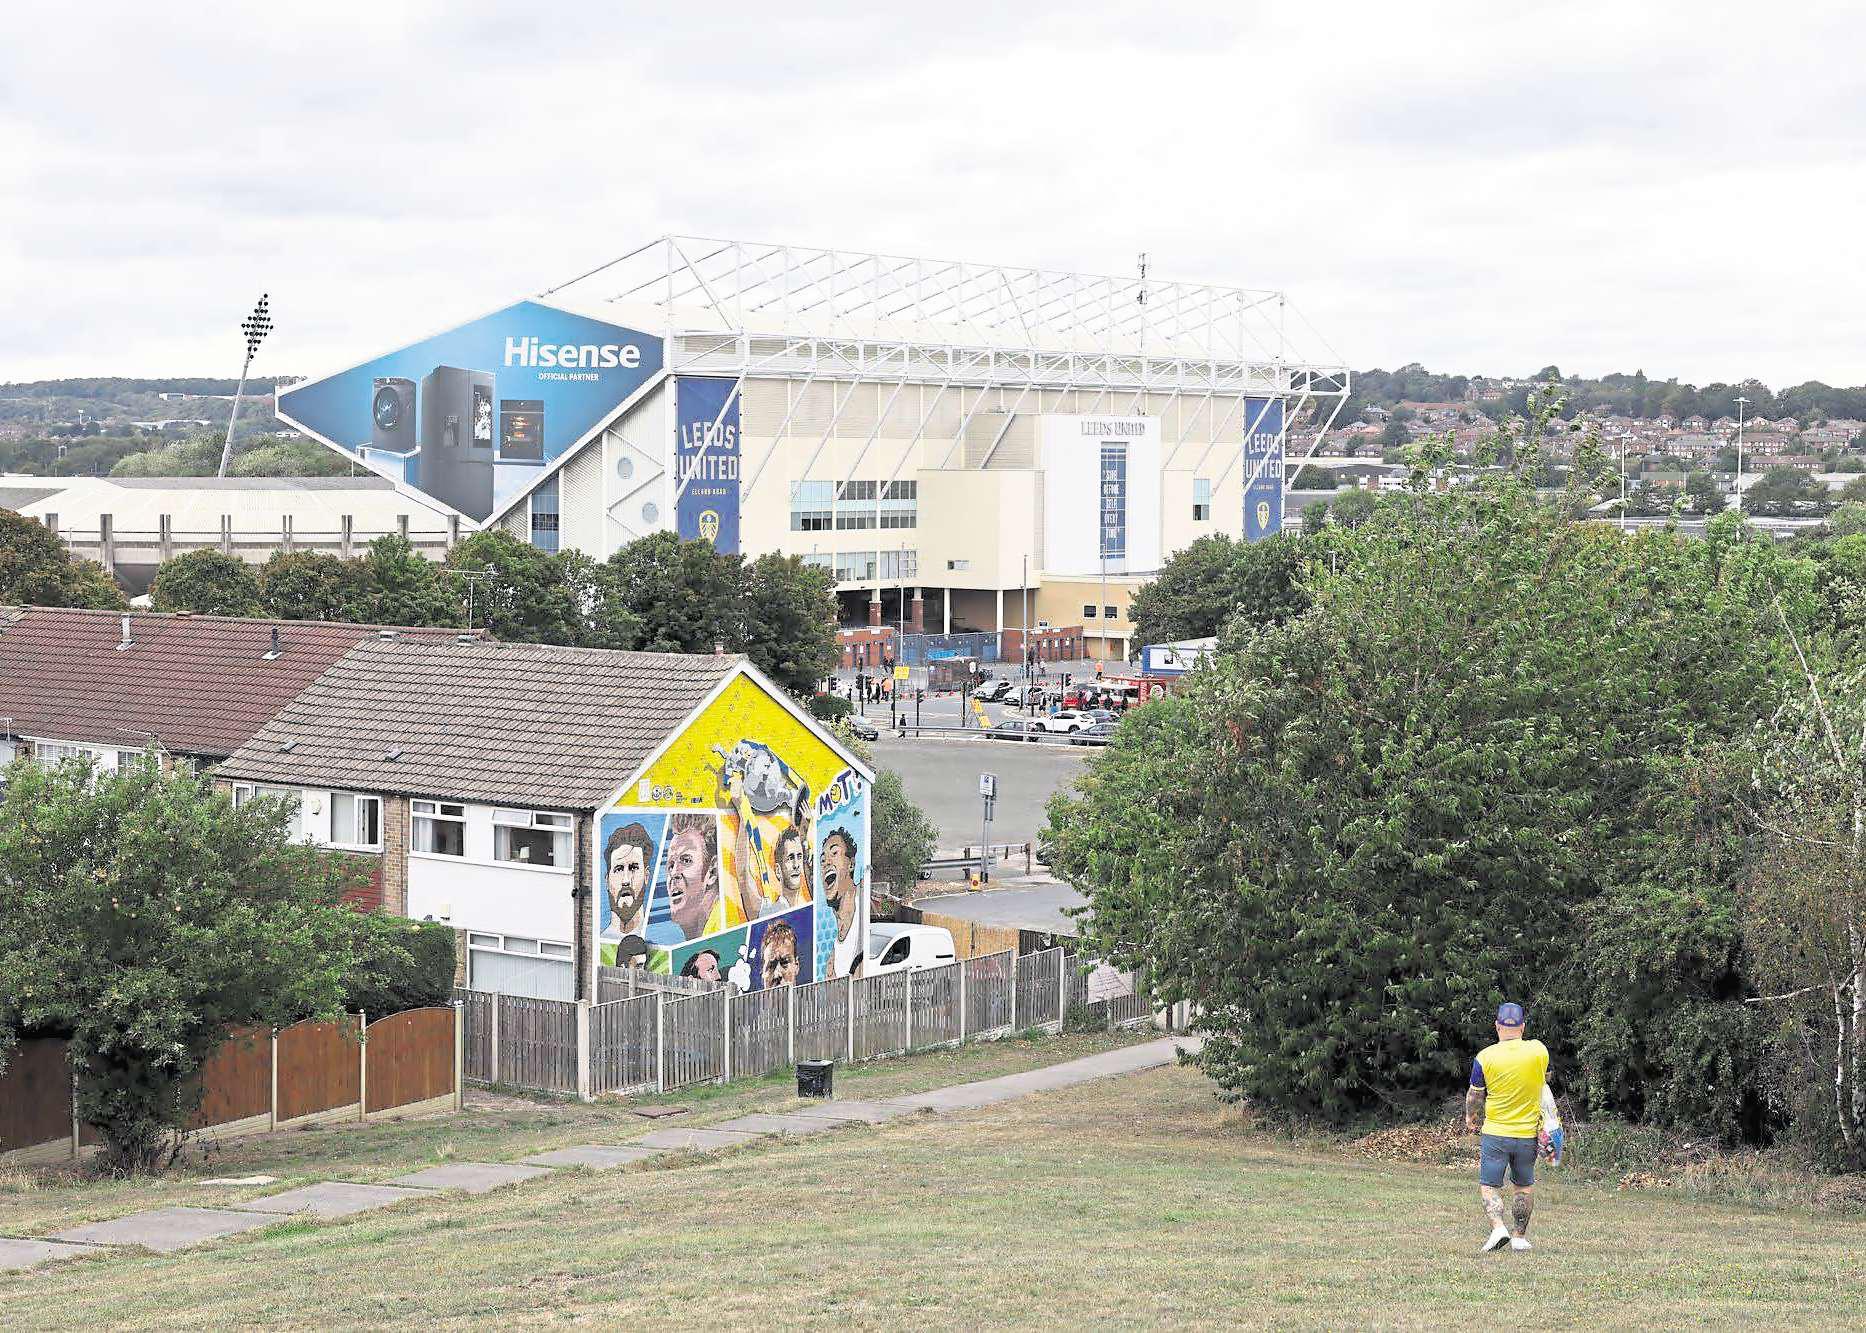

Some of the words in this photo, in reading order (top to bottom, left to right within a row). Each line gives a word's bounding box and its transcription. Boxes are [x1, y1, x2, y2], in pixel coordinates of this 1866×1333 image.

[504, 336, 641, 368] Hisense
[538, 373, 568, 381] OFFICIAL
[569, 373, 599, 381] PARTNER
[682, 421, 736, 449] LEEDS
[679, 455, 738, 480] UNITED
[1246, 459, 1281, 478] UNITED
